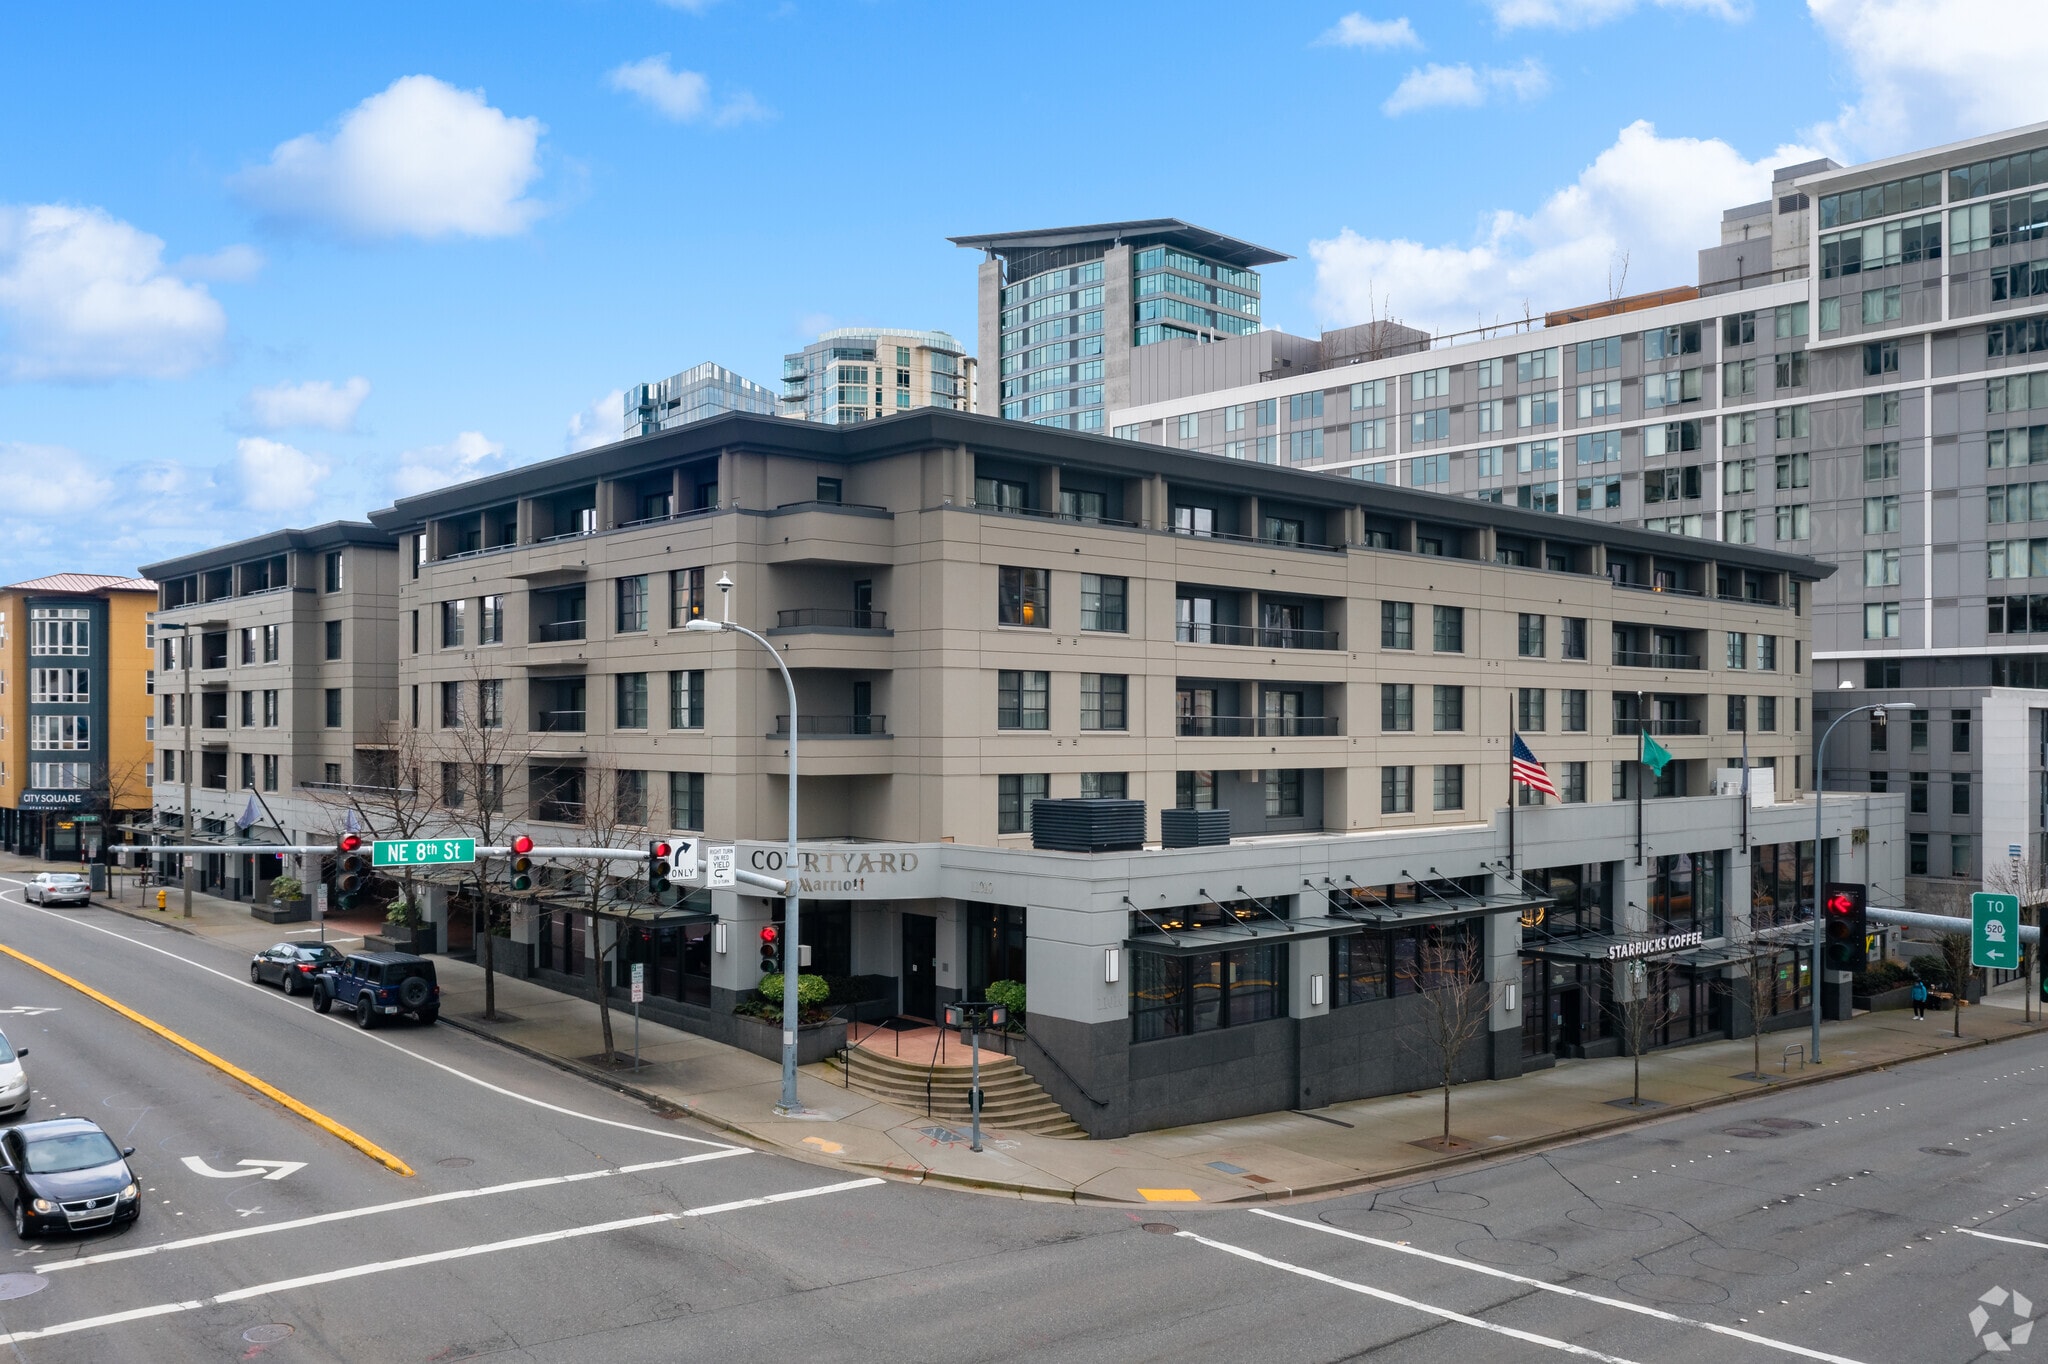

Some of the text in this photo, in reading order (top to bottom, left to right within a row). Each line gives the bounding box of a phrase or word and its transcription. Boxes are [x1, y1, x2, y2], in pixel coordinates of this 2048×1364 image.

[23, 794, 82, 803] CITY SQUARE
[387, 841, 461, 862] NE 8th St
[751, 850, 919, 873] CORTYARD
[671, 868, 694, 878] ONLY
[1986, 900, 2005, 913] TO
[1986, 924, 2003, 934] 520
[1609, 932, 1702, 960] STARBUCKS COFFEE
